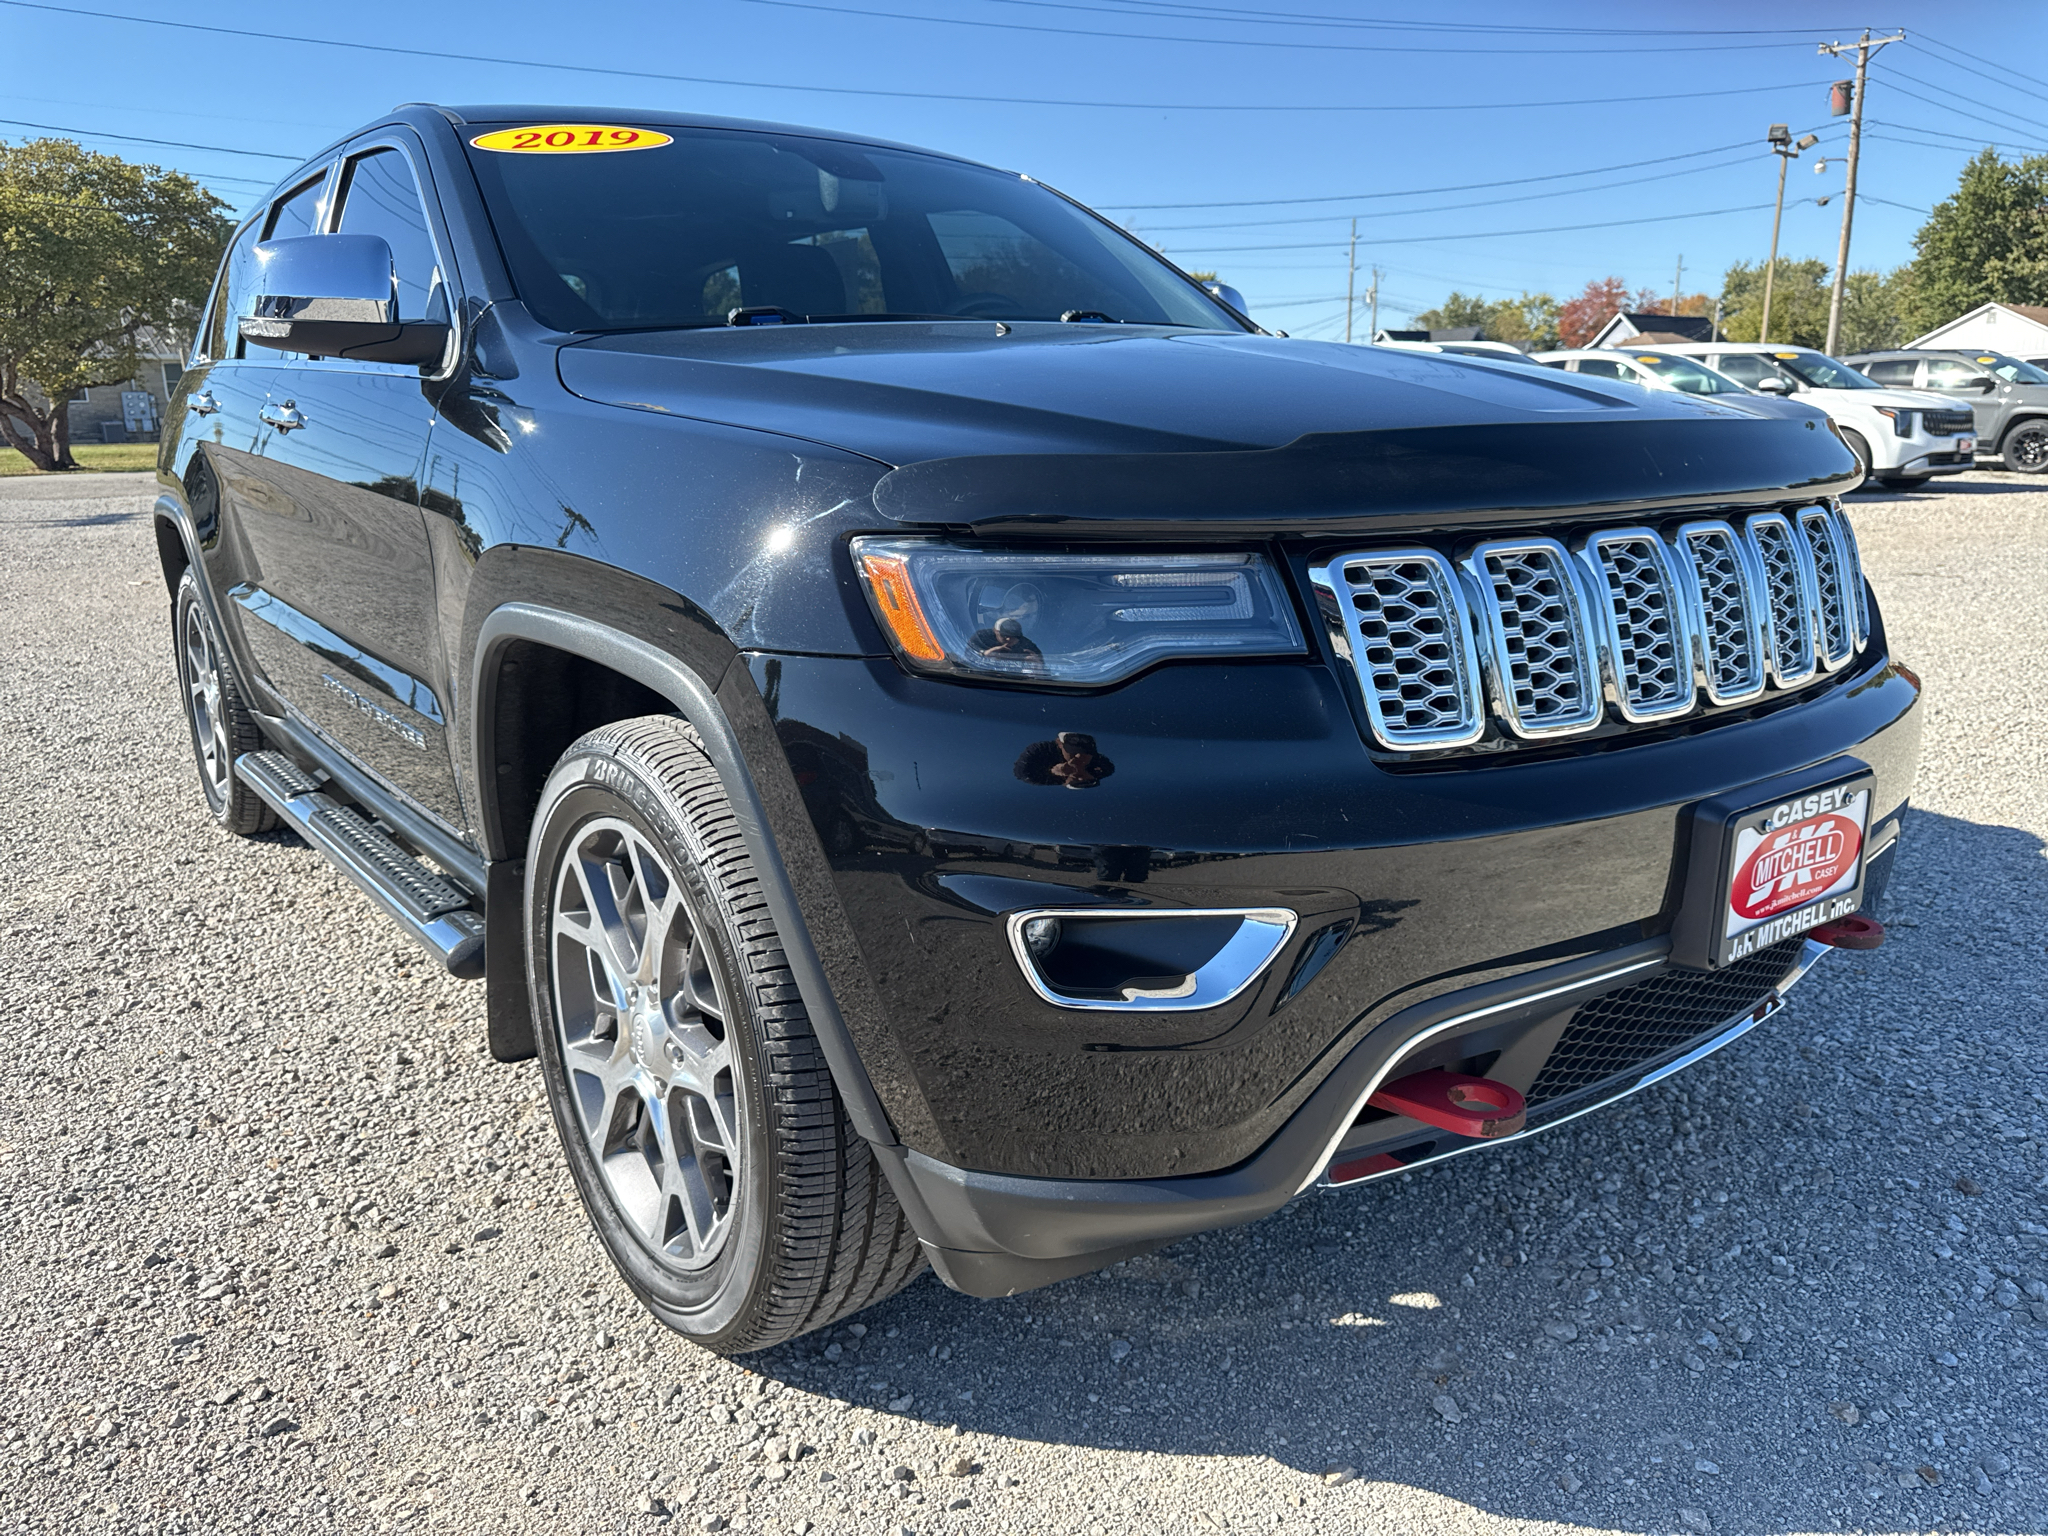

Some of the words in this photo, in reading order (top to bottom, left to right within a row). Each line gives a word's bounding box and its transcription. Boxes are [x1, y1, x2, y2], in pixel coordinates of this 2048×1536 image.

[511, 131, 640, 149] 2019
[1772, 786, 1848, 828] CASEY
[593, 759, 712, 909] BRIDGESTONE
[1756, 836, 1837, 886] MITCHELL
[1814, 865, 1839, 881] CASEY
[1755, 886, 1823, 916] www.jkmitchell.com
[1728, 930, 1755, 962] J&K
[1757, 902, 1827, 949] MITCHELL
